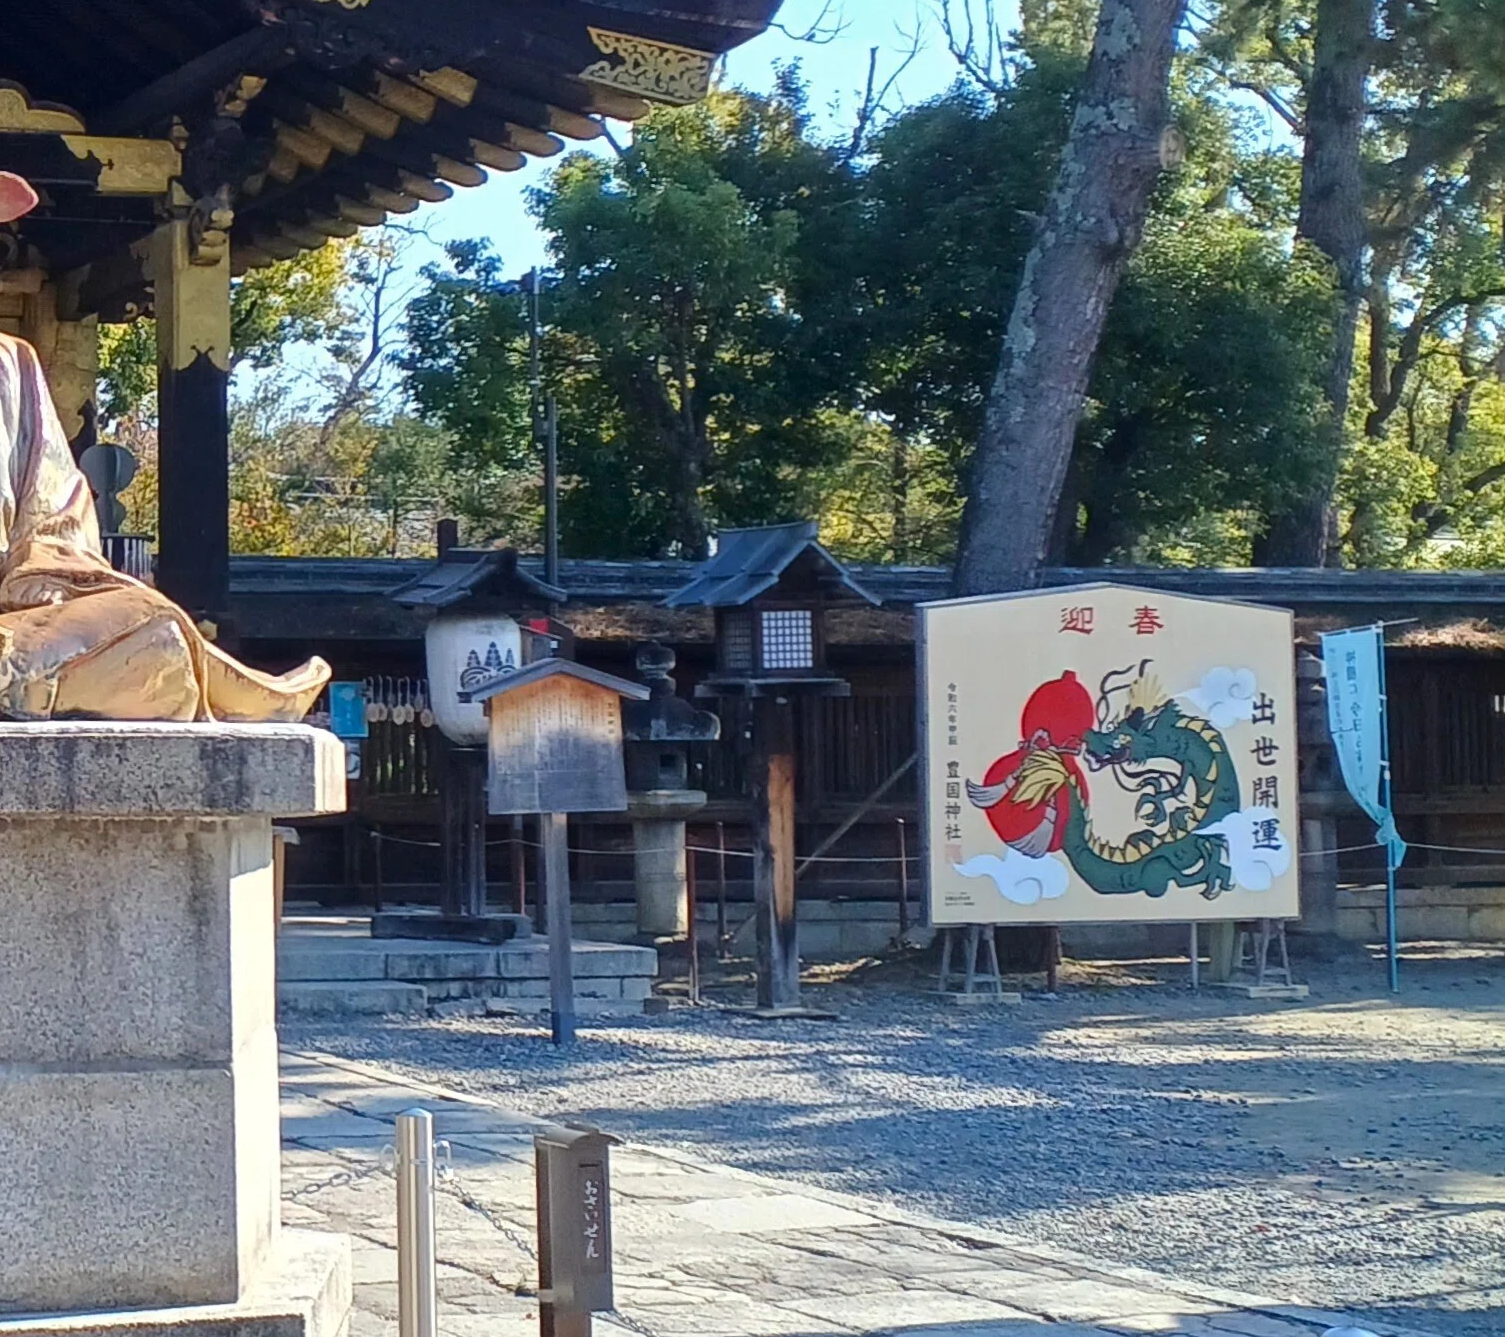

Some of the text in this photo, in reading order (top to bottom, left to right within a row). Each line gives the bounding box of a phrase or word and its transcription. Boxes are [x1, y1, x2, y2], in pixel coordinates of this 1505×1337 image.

[1058, 604, 1164, 635] 迎春
[945, 760, 962, 840] 豊国神社
[1249, 691, 1283, 852] 出世開運
[583, 1180, 600, 1259] おさいせん
